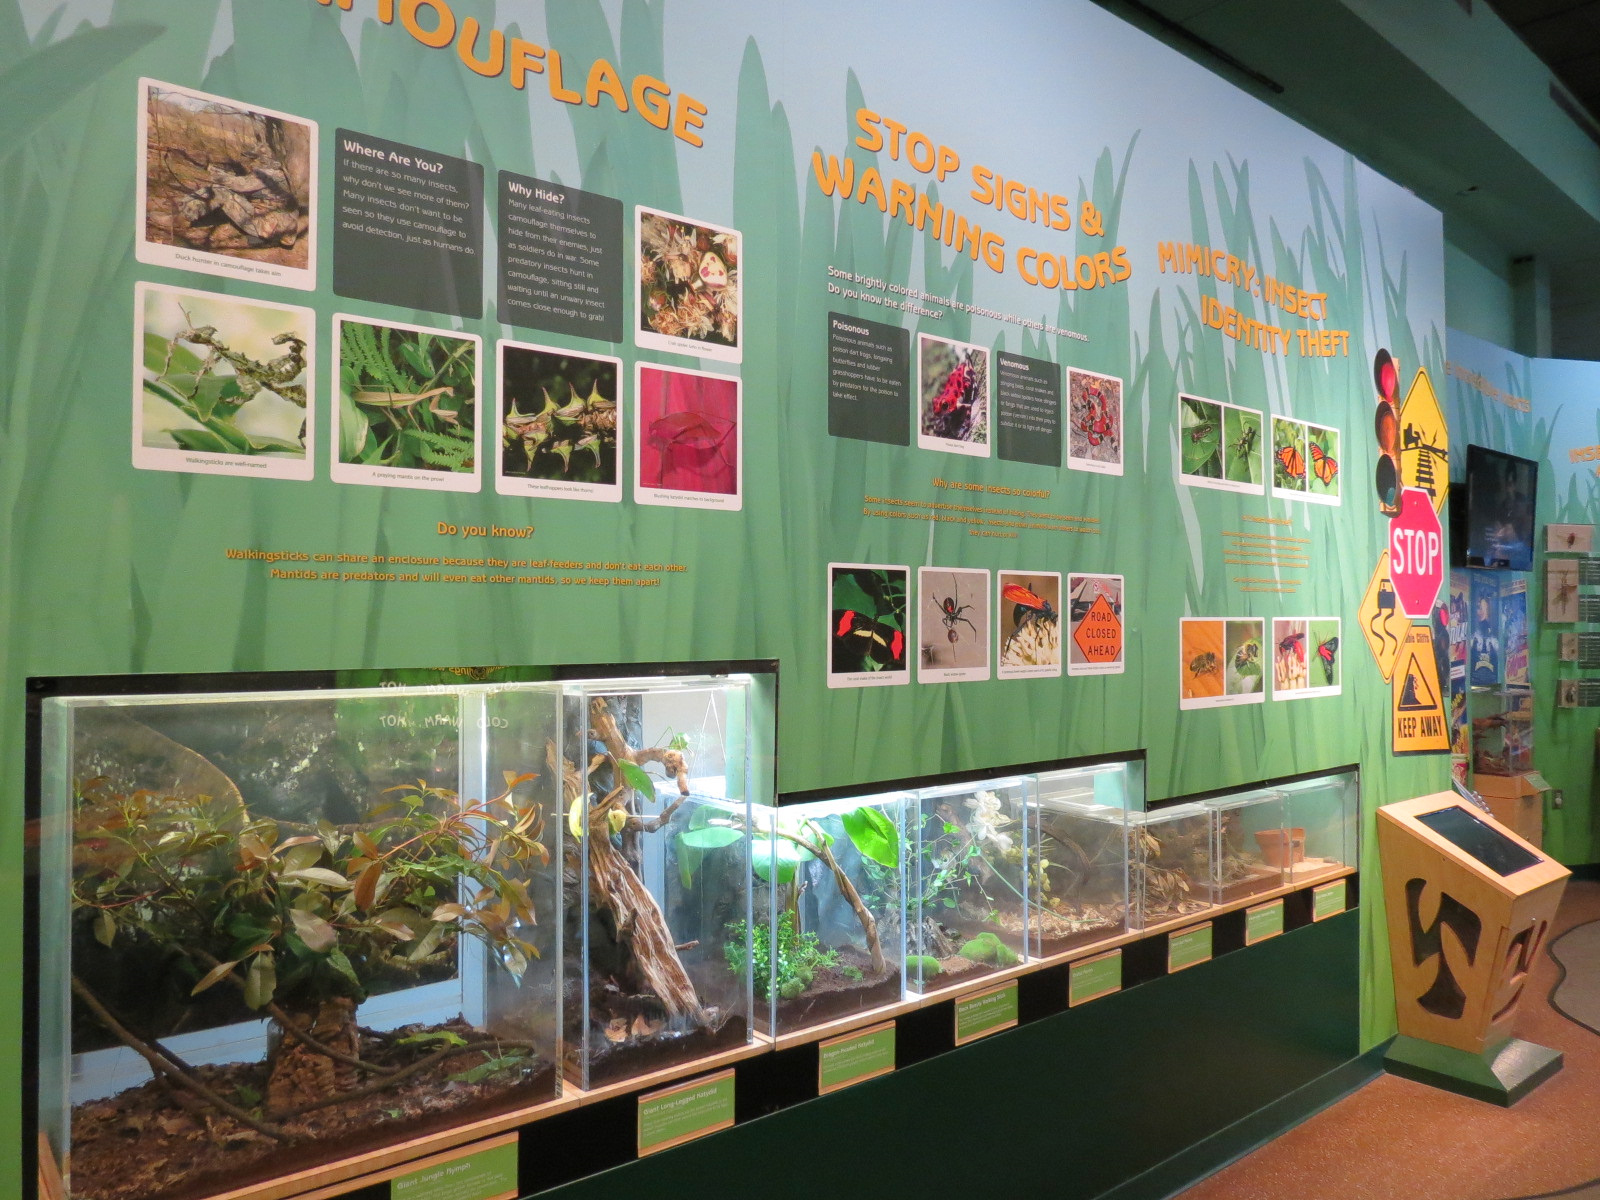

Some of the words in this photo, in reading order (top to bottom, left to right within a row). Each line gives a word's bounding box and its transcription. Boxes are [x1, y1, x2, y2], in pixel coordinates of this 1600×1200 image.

[316, 0, 707, 147] OUFLAGE
[343, 139, 385, 160] Where
[388, 152, 411, 166] Are
[414, 158, 444, 173] You?
[343, 158, 350, 166] If
[352, 160, 374, 173] there
[375, 167, 389, 177] are
[391, 171, 402, 179] so
[403, 174, 426, 186] many
[428, 179, 458, 193] insects,
[855, 107, 960, 182] STOP
[970, 164, 1071, 232] SIGNS
[1079, 200, 1105, 238] &
[342, 175, 360, 186] why
[361, 179, 382, 190] don't
[383, 185, 395, 193] we
[397, 188, 412, 197] see
[413, 192, 435, 202] more
[436, 195, 445, 204] of
[445, 198, 470, 210] them?
[508, 181, 532, 198] Why
[535, 187, 565, 204] Hide?
[343, 189, 365, 202] Many
[367, 194, 397, 208] insects
[399, 202, 420, 214] don't
[421, 208, 441, 218] want
[442, 212, 451, 221] to
[453, 214, 463, 224] be
[508, 198, 527, 210] Many
[528, 203, 565, 220] leaf-eating
[566, 213, 590, 225] insects
[342, 206, 363, 216] seen
[364, 210, 375, 219] so
[376, 212, 395, 224] they
[396, 218, 412, 227] use
[413, 220, 457, 237] camouflage
[458, 230, 467, 239] to
[508, 214, 548, 228] camouflage
[549, 223, 588, 238] themselves
[589, 231, 597, 240] to
[811, 151, 1005, 274] WARNING
[1016, 245, 1132, 291] COLORS
[342, 221, 364, 232] avoid
[405, 234, 421, 244] just
[422, 237, 432, 246] as
[433, 240, 463, 253] humans
[508, 227, 523, 237] hide
[525, 230, 541, 240] from
[542, 234, 557, 244] their
[559, 239, 589, 251] enemies,
[590, 245, 603, 255] just
[508, 256, 542, 270] predatory
[543, 262, 568, 274] insects
[569, 268, 586, 278] hunt
[586, 271, 594, 279] in
[518, 243, 545, 255] soldiers
[546, 249, 556, 258] do
[580, 256, 600, 267] Some
[508, 270, 550, 285] camouflage,
[551, 278, 572, 290] sitting
[573, 282, 585, 291] still
[586, 285, 600, 294] and
[1157, 241, 1261, 298] MIMICRY:
[1265, 275, 1328, 321] INSECT
[507, 283, 532, 296] waiting
[533, 288, 549, 298] until
[550, 292, 559, 300] an
[560, 294, 584, 305] unwary
[585, 299, 605, 309] insect
[507, 298, 531, 309] comes
[533, 302, 552, 312] close
[553, 306, 578, 318] enough
[580, 310, 587, 319] to
[828, 282, 841, 296] Do
[842, 288, 858, 301] you
[860, 290, 882, 305] know
[884, 296, 898, 309] the
[900, 300, 944, 320] difference?
[828, 265, 853, 281] Some
[855, 271, 887, 291] brightly
[889, 282, 918, 299] colored
[920, 290, 950, 307] animals
[951, 299, 964, 310] are
[966, 304, 1002, 321] poisonous
[1003, 311, 1021, 325] while
[1022, 317, 1044, 331] others
[1045, 324, 1056, 334] are
[1056, 326, 1090, 342] venomous.
[832, 320, 870, 336] Poisonous
[1201, 294, 1292, 357] IDENTITY
[1296, 330, 1350, 358] THEFT
[1000, 357, 1029, 371] Venomous
[185, 457, 224, 466] Walkingsticks
[932, 477, 948, 490] Why
[950, 480, 963, 490] are
[964, 482, 984, 492] some
[985, 483, 1011, 495] insects
[1013, 488, 1021, 496] so
[1022, 488, 1051, 499] colorful?
[437, 521, 457, 535] Do
[461, 525, 487, 539] you
[491, 524, 535, 538] know?
[225, 548, 309, 563] Walkingsticks
[313, 552, 334, 562] can
[337, 552, 368, 563] share
[371, 554, 385, 564] an
[388, 554, 439, 565] enclosure
[442, 556, 484, 567] because
[487, 557, 509, 569] they
[511, 559, 527, 568] are
[529, 558, 583, 569] leaf-feeders
[585, 560, 602, 570] and
[604, 561, 626, 571] don't
[627, 562, 642, 571] eat
[643, 562, 663, 571] each
[1393, 527, 1440, 576] STOP
[270, 568, 317, 580] Mantids
[320, 570, 339, 580] are
[342, 570, 396, 583] predators
[399, 572, 418, 582] and
[421, 572, 440, 582] will
[443, 574, 467, 583] even
[470, 574, 487, 583] eat
[490, 574, 515, 584] other
[518, 575, 558, 585] mantids,
[561, 577, 571, 585] so
[574, 577, 587, 585] we
[589, 577, 610, 587] keep
[612, 577, 633, 586] them
[635, 577, 661, 587] apart!
[1091, 612, 1112, 622] ROAD
[1086, 628, 1117, 639] CLOSED
[1088, 645, 1116, 656] AHEAD
[1398, 716, 1417, 738] KEEP
[1420, 715, 1443, 737] AWAY
[643, 1105, 659, 1115] Giant
[397, 1179, 418, 1190] Giant
[421, 1171, 445, 1183] Jungle
